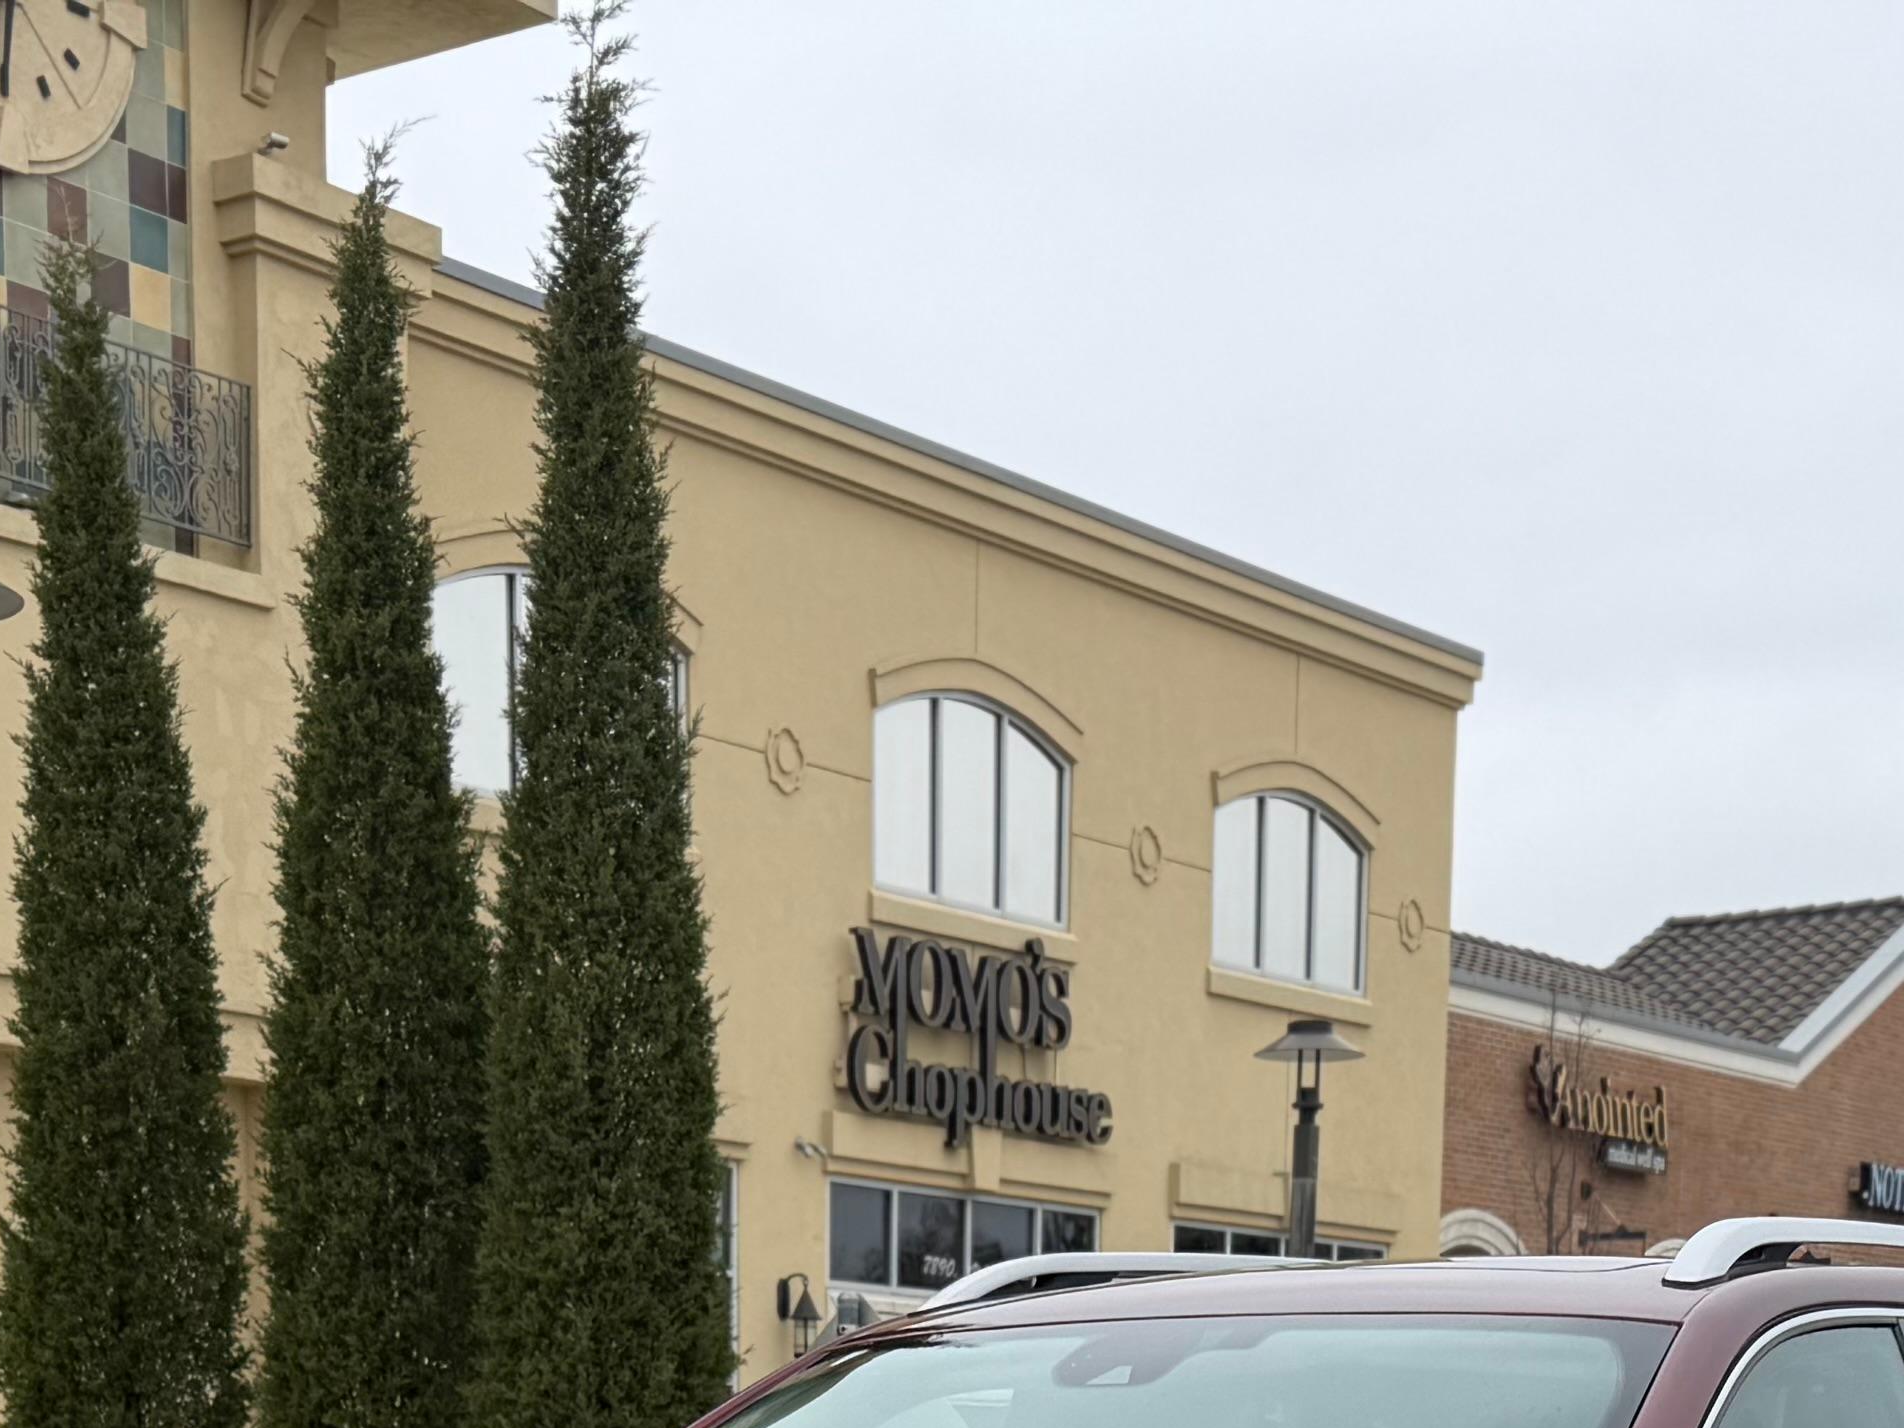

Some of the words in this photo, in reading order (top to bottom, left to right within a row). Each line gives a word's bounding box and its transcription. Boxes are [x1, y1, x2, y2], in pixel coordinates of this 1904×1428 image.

[848, 926, 1073, 1050] MOMO'S
[846, 1023, 1114, 1149] Chophouse
[1550, 1064, 1670, 1148] Anointed
